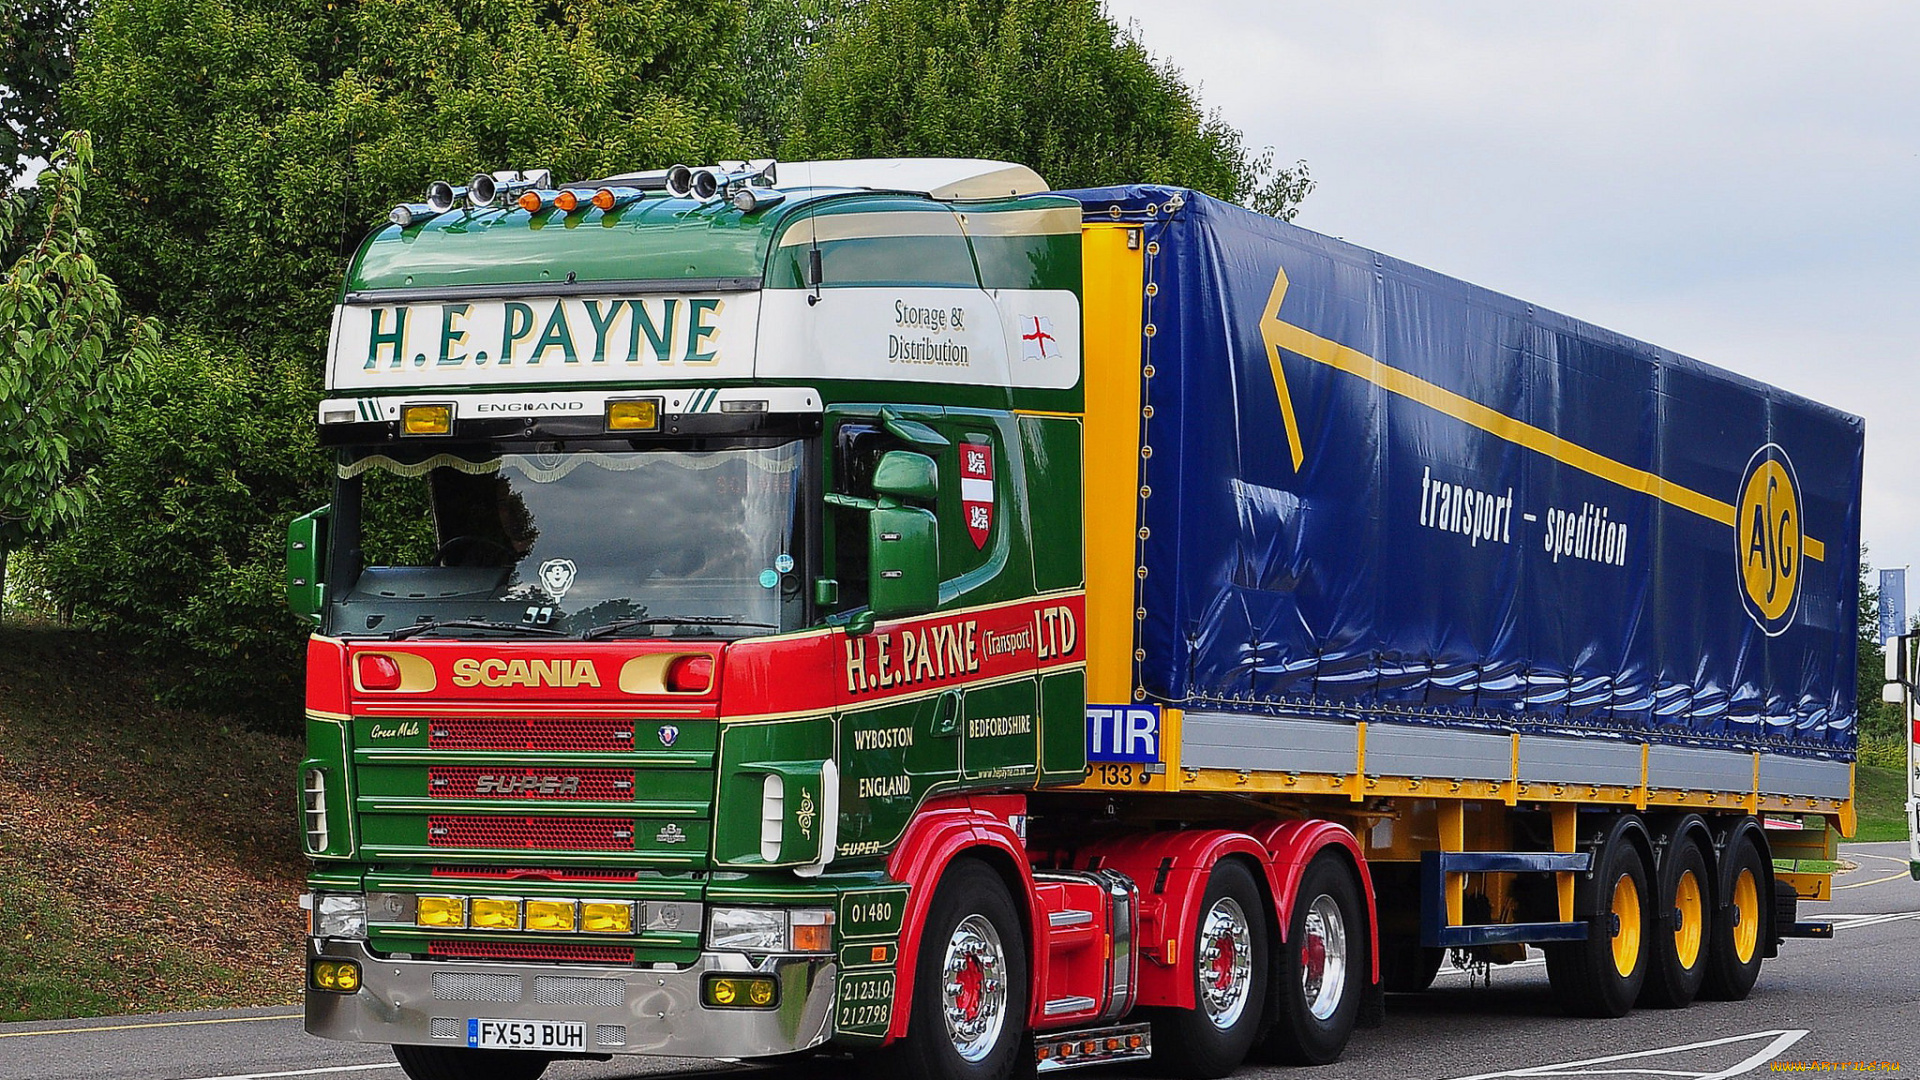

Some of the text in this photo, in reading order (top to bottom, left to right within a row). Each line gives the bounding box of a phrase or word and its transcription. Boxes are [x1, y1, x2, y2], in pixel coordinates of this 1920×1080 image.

[895, 299, 964, 333] Storage &
[888, 334, 968, 365] Distribution
[477, 402, 584, 412] ENGLAND
[1419, 466, 1513, 547] transport
[1545, 502, 1628, 566] spedition
[1748, 476, 1793, 604] ASG
[982, 621, 1035, 661] (Transport)
[1034, 606, 1077, 658] LTD
[452, 658, 601, 687] SCANIA
[371, 724, 397, 738] Green
[854, 727, 913, 750] WYBOSTON
[968, 715, 1031, 739] BEDFORDSHIRE
[1087, 710, 1156, 755] TIR
[475, 776, 580, 794] SUPER
[1099, 764, 1133, 785] 133
[859, 776, 911, 798] ENGLAND
[841, 841, 880, 856] SUPER
[852, 903, 892, 923] 01480
[844, 979, 890, 1001] 212310
[841, 1004, 888, 1026] 212798
[482, 1023, 583, 1047] FX53 BUH
